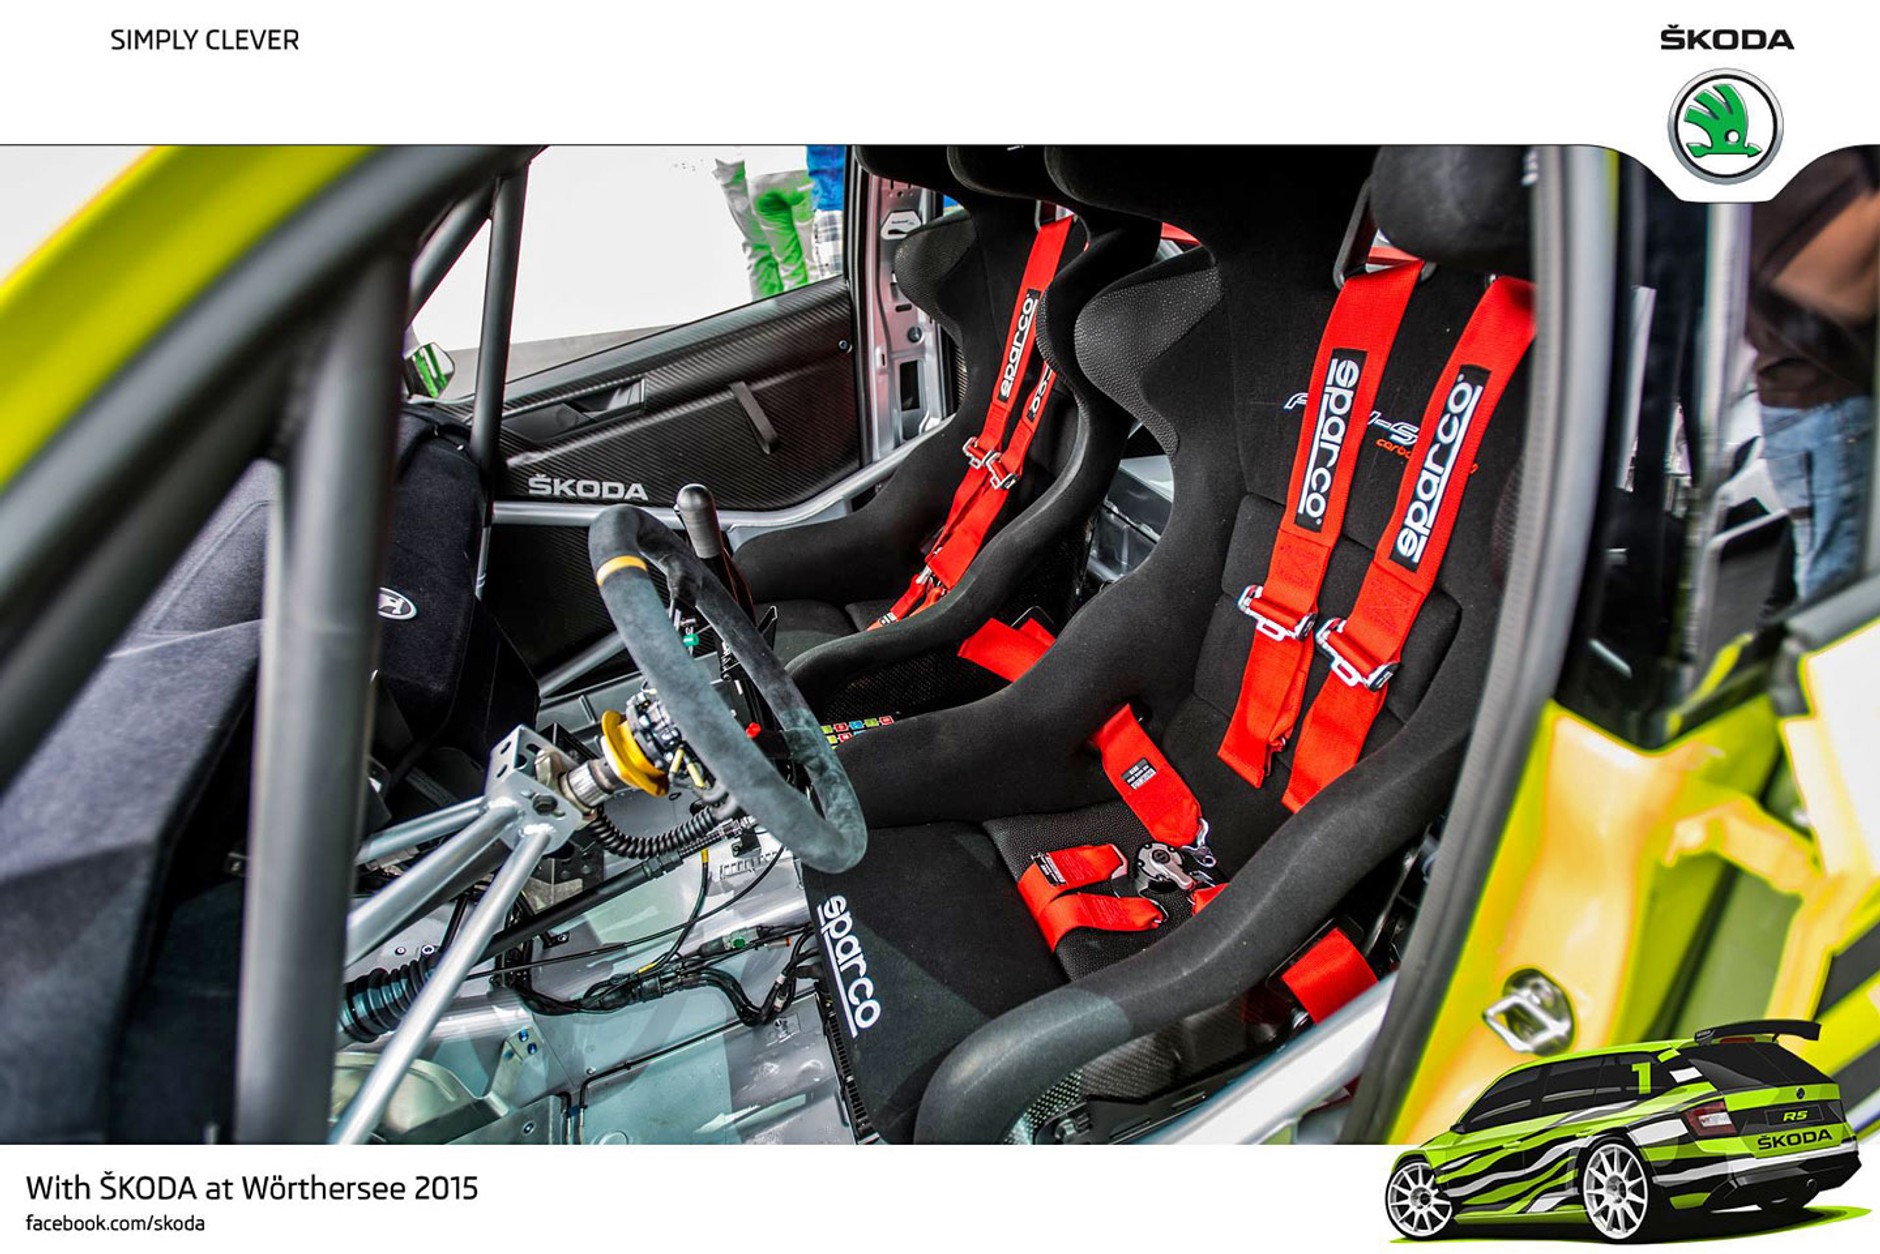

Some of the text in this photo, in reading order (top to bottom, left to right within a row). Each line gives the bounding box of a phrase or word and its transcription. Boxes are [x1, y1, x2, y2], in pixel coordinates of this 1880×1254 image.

[1001, 298, 1039, 398] sparco
[528, 473, 649, 501] ŠKODA
[1298, 358, 1360, 519] sparco
[1396, 382, 1483, 563] sparco
[817, 895, 881, 1039] sparco
